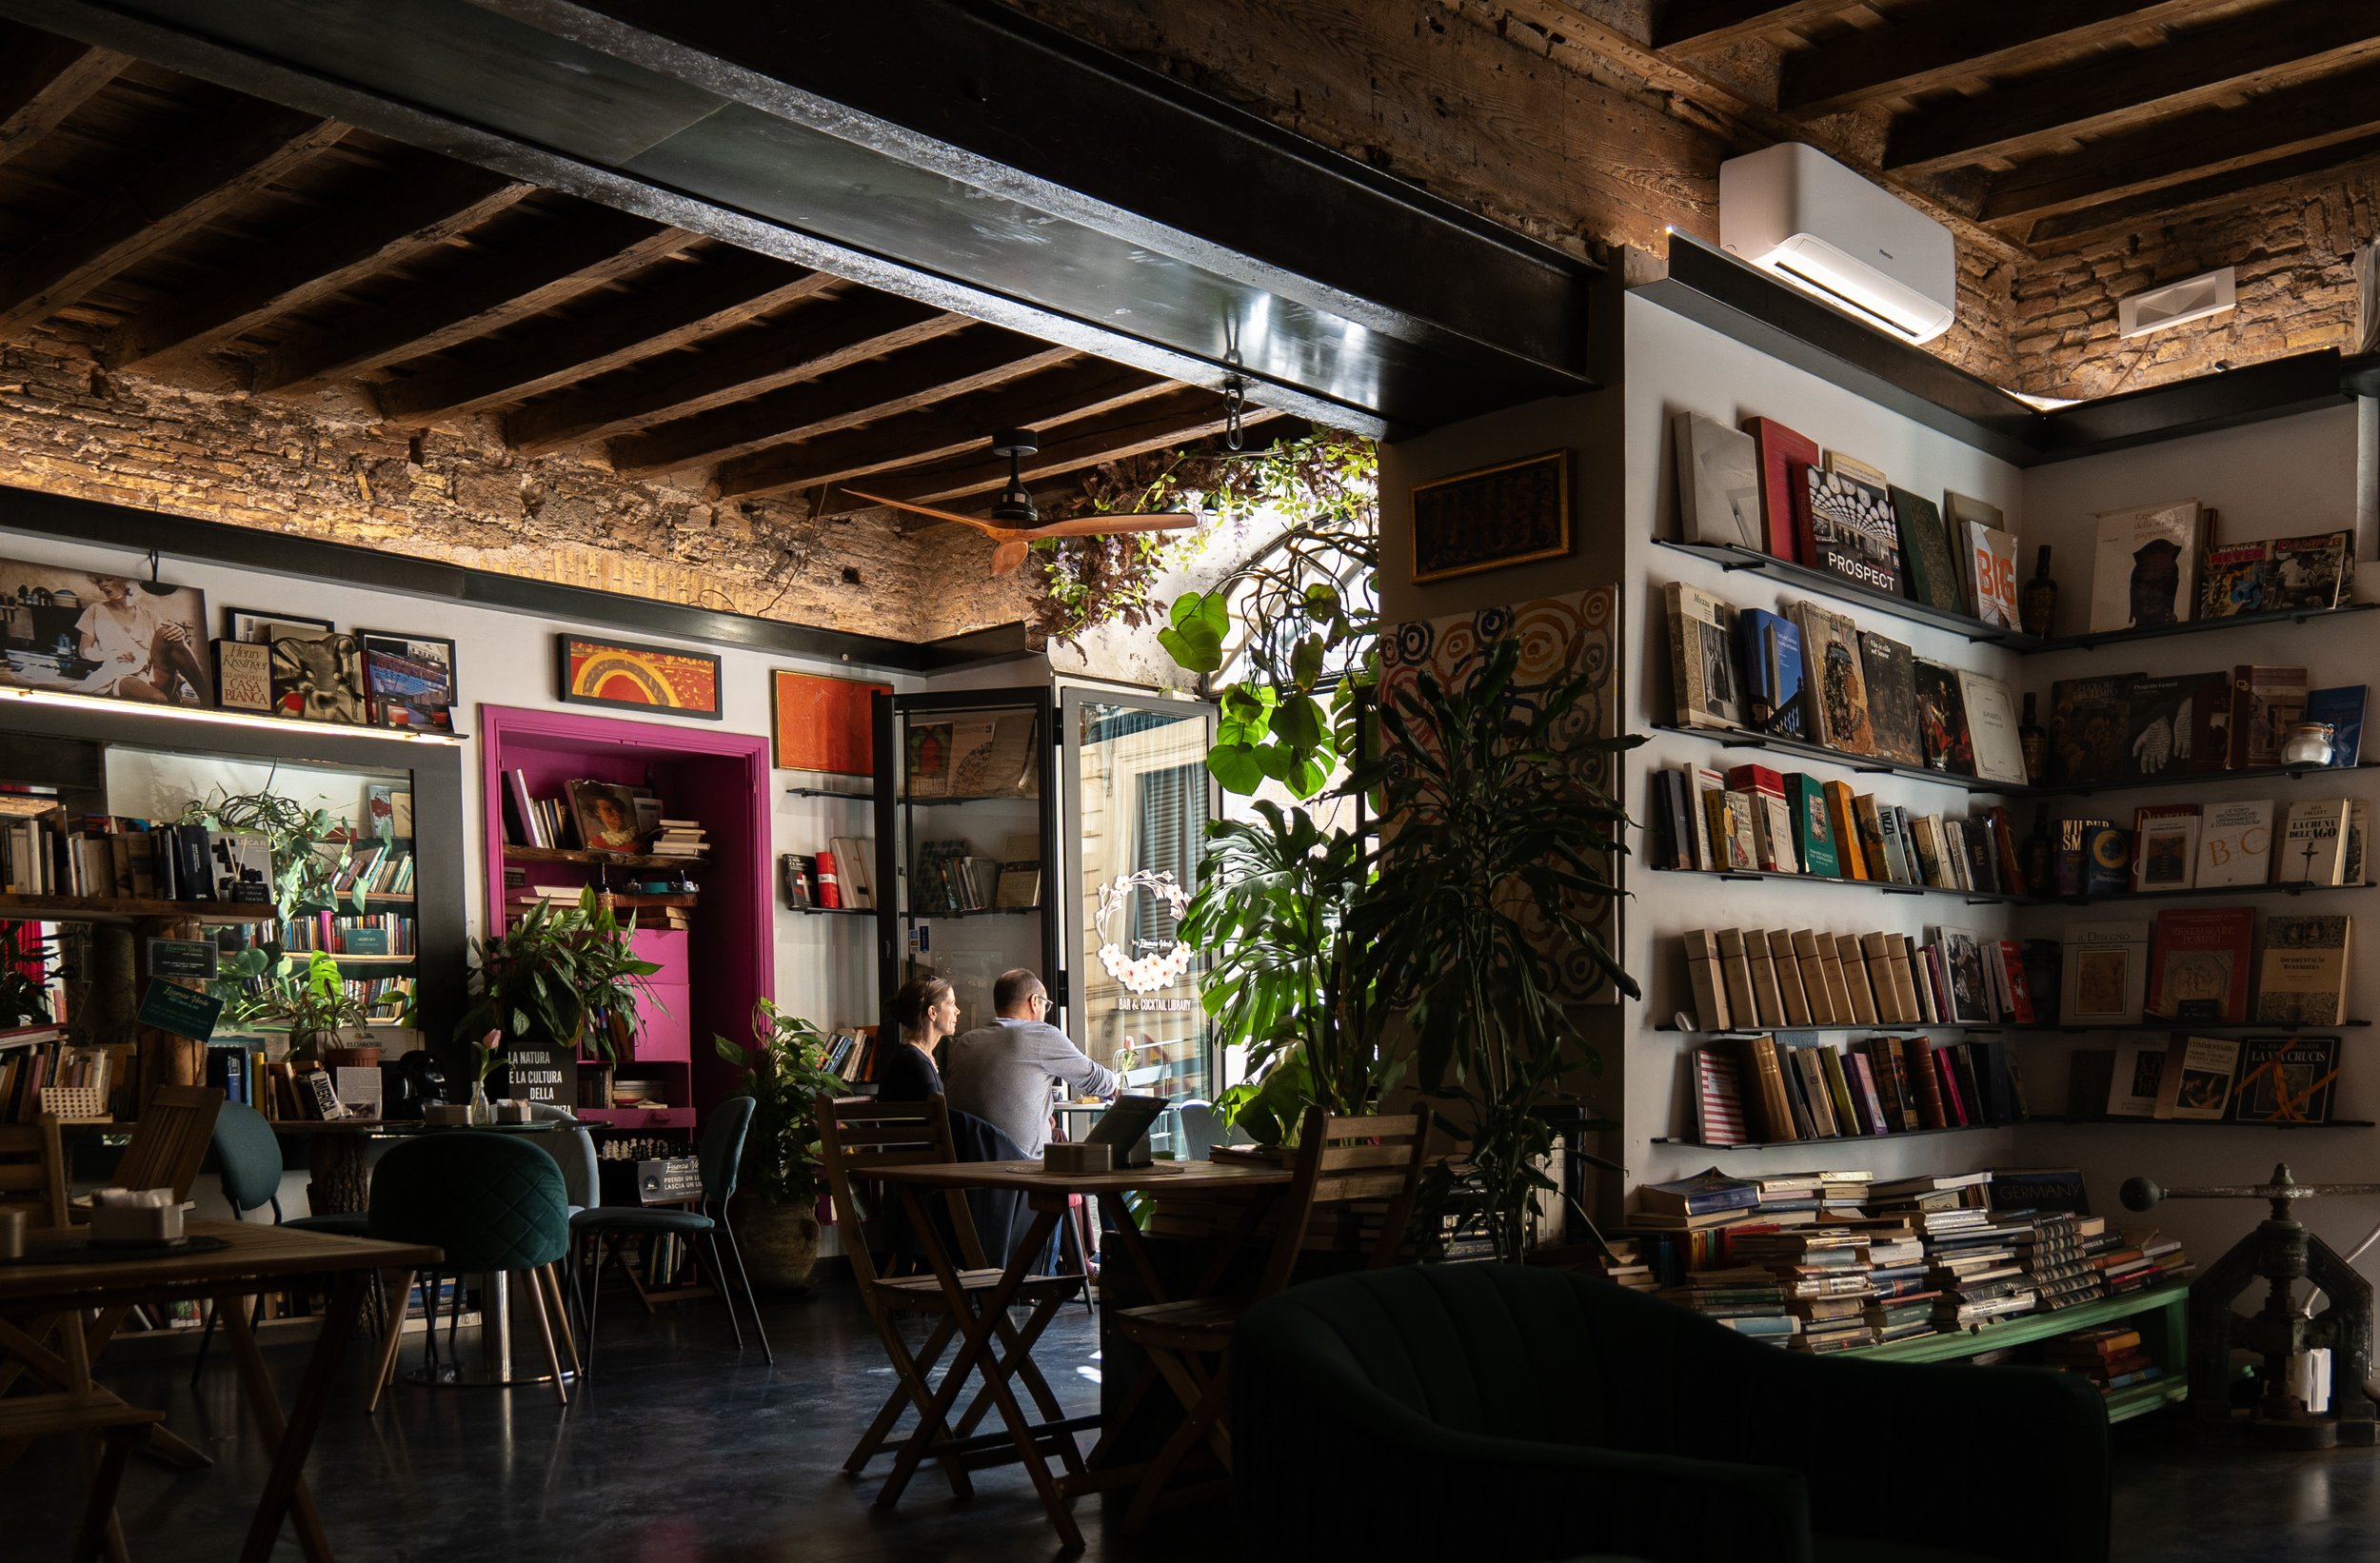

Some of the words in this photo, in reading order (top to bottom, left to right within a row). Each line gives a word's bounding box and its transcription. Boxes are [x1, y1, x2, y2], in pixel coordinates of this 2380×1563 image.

[2211, 548, 2264, 564] NEVER
[1828, 551, 1895, 591] PROSPECT
[1976, 547, 2015, 605] BIG
[230, 644, 262, 660] Henry
[223, 655, 268, 673] Kissinger
[230, 678, 262, 693] CASA
[225, 688, 268, 705] BIANCA
[2290, 825, 2338, 839] DELL'AGO
[2292, 821, 2303, 830] LA
[2303, 820, 2335, 829] CRUNA
[2209, 839, 2231, 867] B
[2240, 827, 2270, 855] C
[2171, 925, 2235, 937] RESTAURARE
[2183, 935, 2221, 944] POMPEI
[1119, 998, 1131, 1011] BAR
[1131, 999, 1140, 1011] &
[1140, 999, 1167, 1011] COCKTAIL
[1167, 999, 1191, 1012] LIBRARY
[2189, 1040, 2235, 1052] COMMENTARIO
[508, 1051, 519, 1064] LA
[520, 1051, 550, 1064] NATURA
[2251, 1050, 2266, 1061] LA
[2267, 1050, 2287, 1061] VA
[2287, 1050, 2325, 1061] CRUCIS
[516, 1071, 526, 1083] LA
[528, 1071, 563, 1084] CULTURA
[312, 1078, 336, 1113] AMERICA
[529, 1087, 554, 1100] DELLA
[1998, 1183, 2081, 1200] GERMANY
